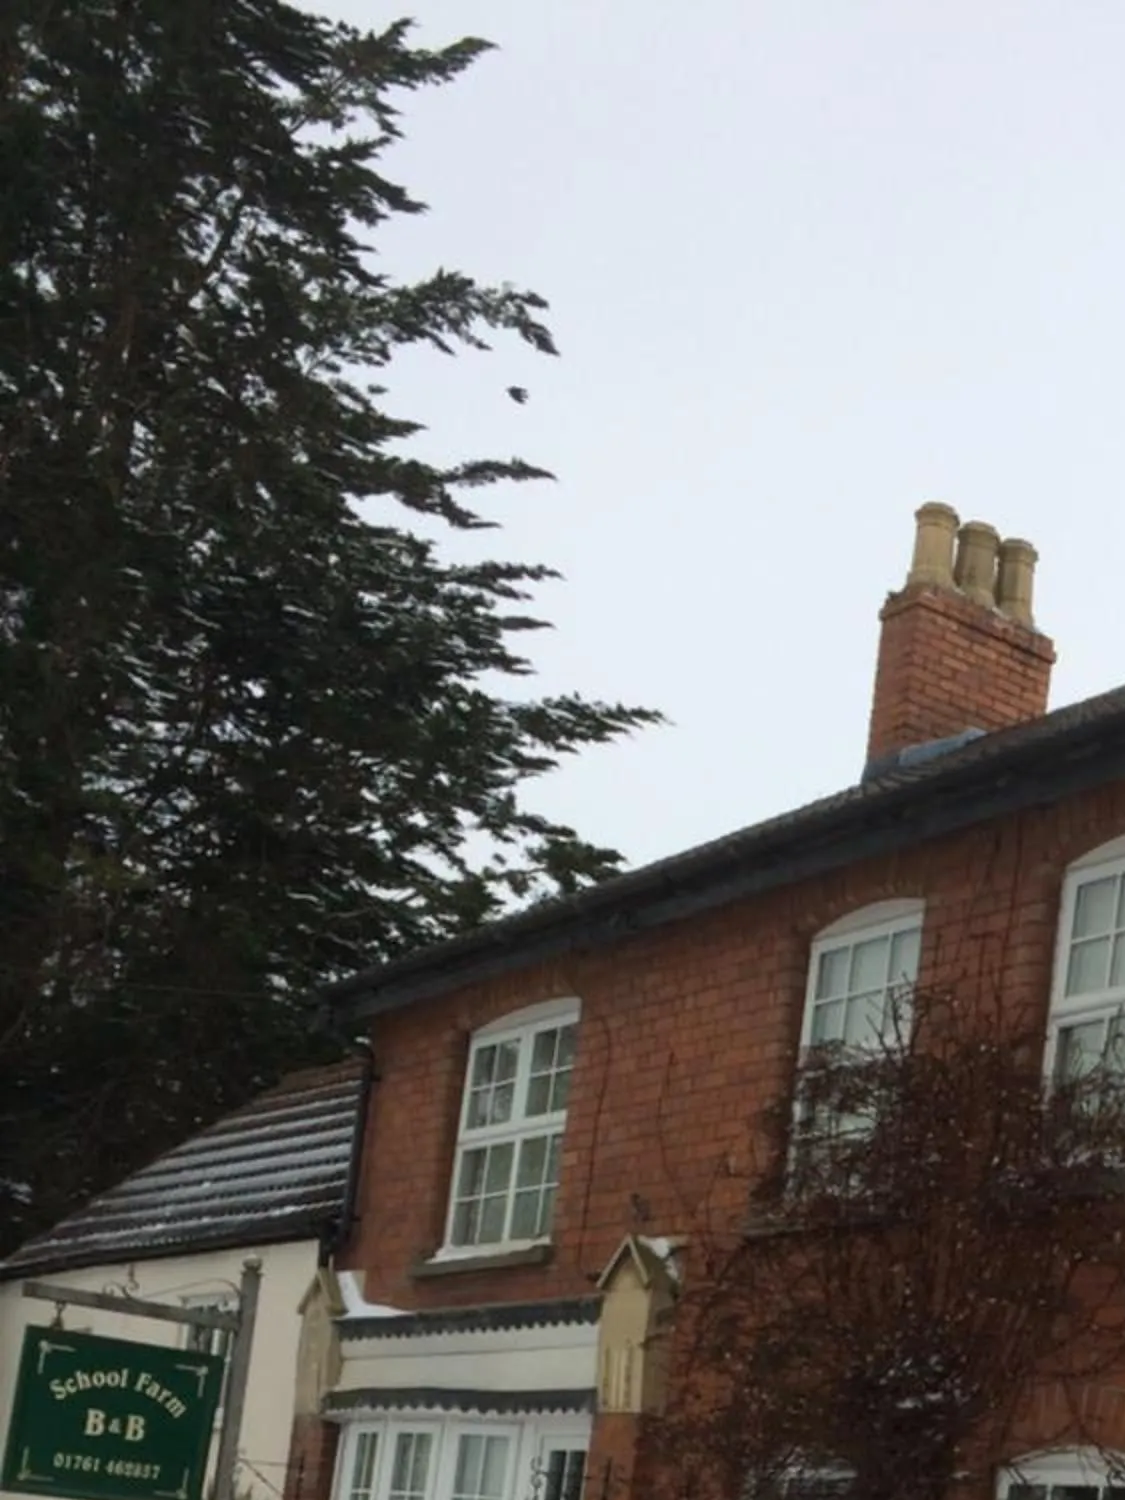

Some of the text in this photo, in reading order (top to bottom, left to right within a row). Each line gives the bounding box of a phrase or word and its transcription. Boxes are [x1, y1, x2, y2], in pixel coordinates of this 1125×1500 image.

[50, 1368, 187, 1418] School Farm
[53, 1452, 100, 1473] 01761
